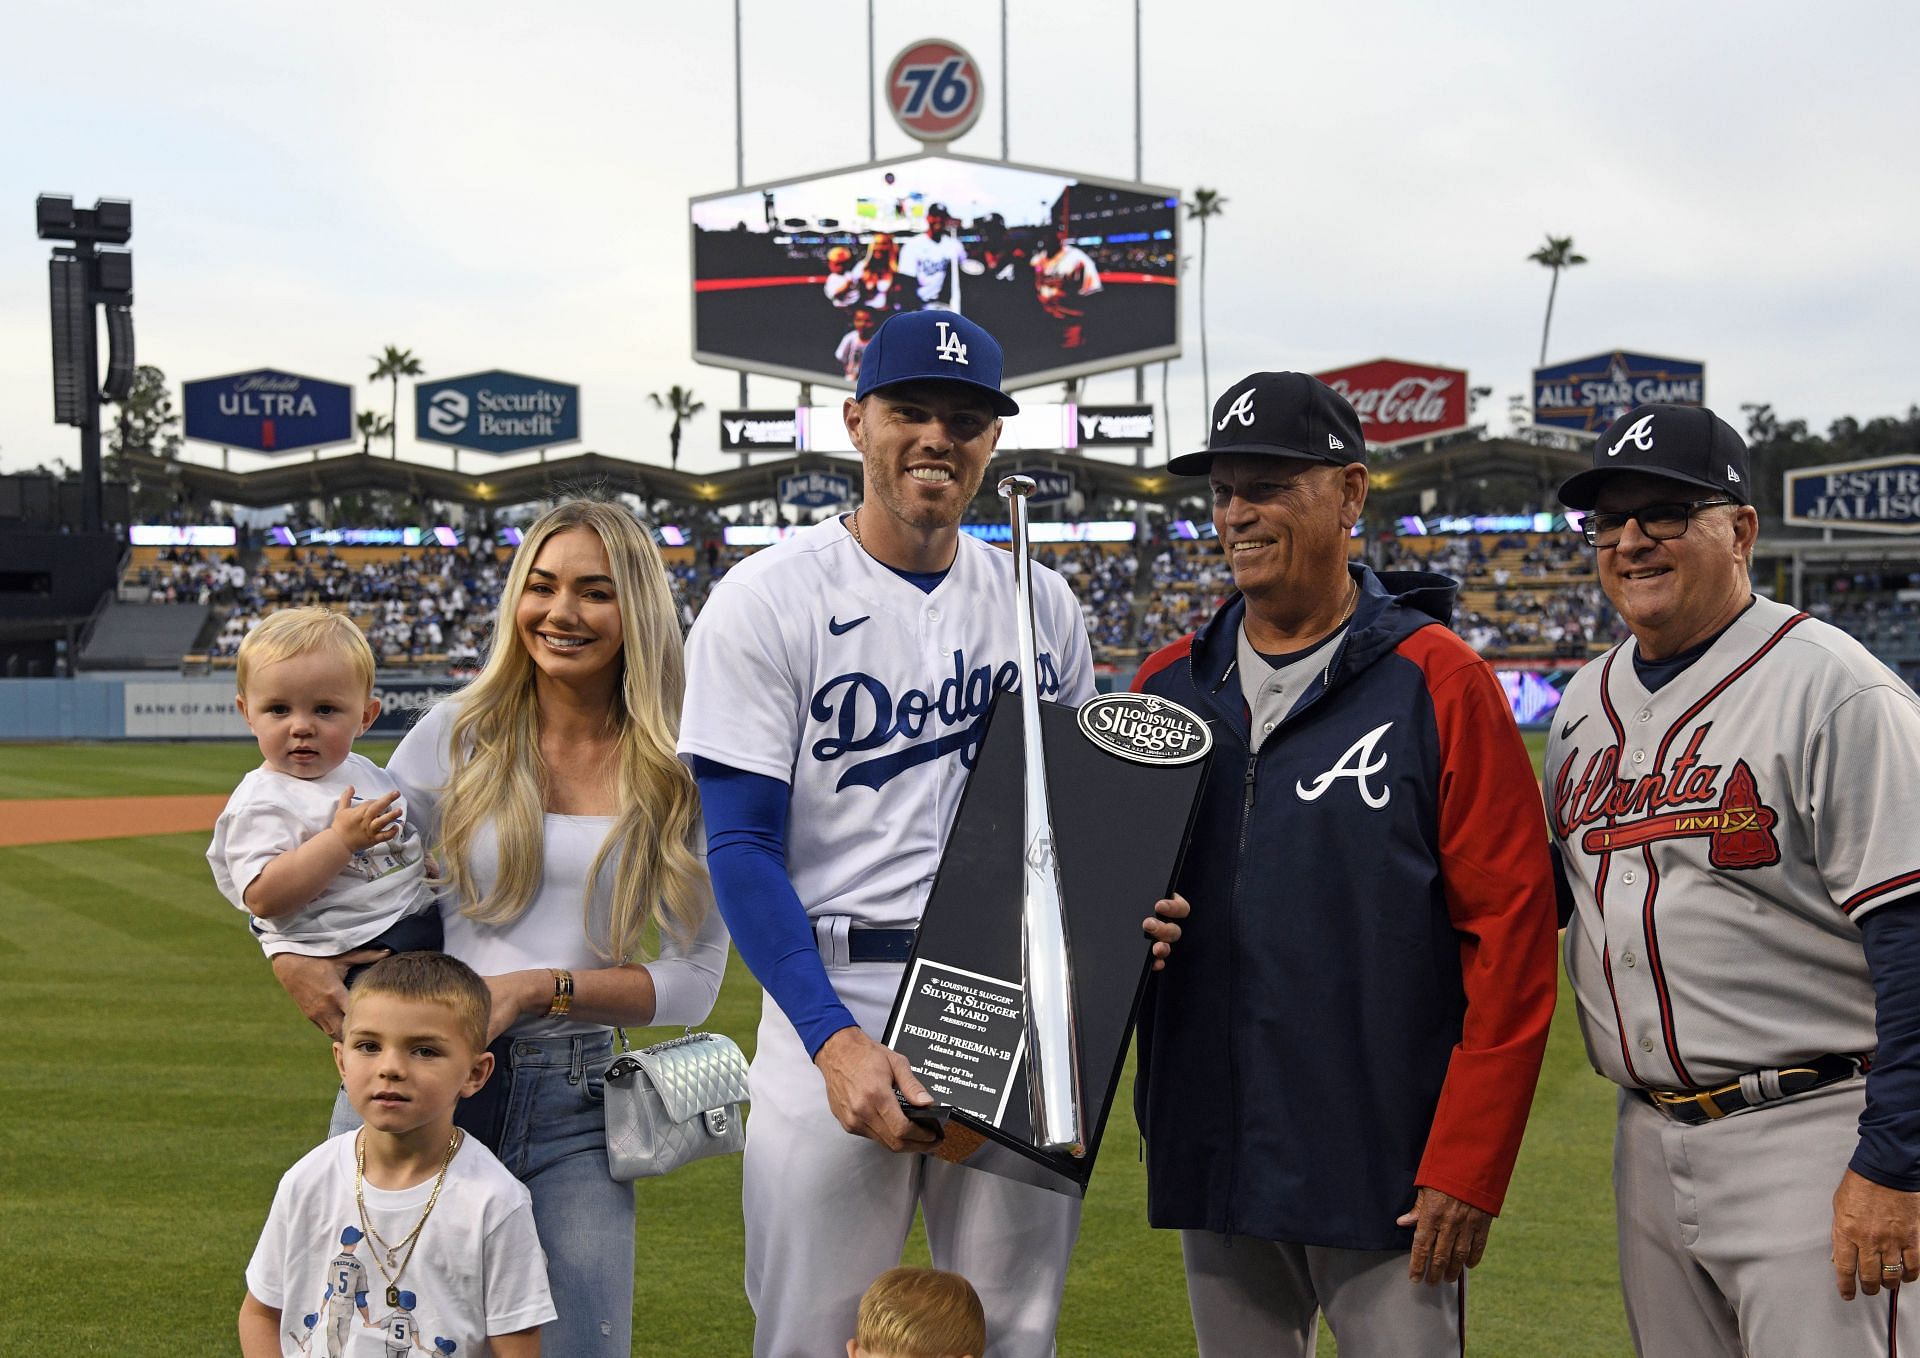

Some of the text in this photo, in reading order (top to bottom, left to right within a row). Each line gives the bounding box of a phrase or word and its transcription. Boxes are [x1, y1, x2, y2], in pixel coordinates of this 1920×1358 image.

[897, 56, 973, 118] 76
[936, 322, 968, 365] LA
[219, 393, 317, 416] ULTRA
[476, 389, 566, 416] Security
[1580, 382, 1633, 406] STAR
[1634, 379, 1699, 403] GAME
[1217, 388, 1256, 431] A
[479, 413, 555, 436] Benefit
[1608, 414, 1654, 456] A
[809, 472, 847, 501] BEAM
[134, 703, 176, 715] BANK
[181, 703, 199, 715] OF
[811, 649, 1060, 770] Dodges
[1123, 707, 1193, 733] LOUISVILLE
[1095, 706, 1195, 750] Slugger
[1296, 722, 1393, 808] A
[1554, 720, 1722, 841] Atlanta
[940, 979, 978, 995] LOUISVILLE
[920, 983, 1017, 1019] SILVER SLUGGER
[944, 1002, 990, 1023] AWARD
[939, 1015, 987, 1033] PRESENTED TO
[903, 1023, 1011, 1061] FREDDIE FREEMAN-1B
[928, 1043, 980, 1063] Atlanta Braves
[923, 1059, 974, 1079] Member Of The
[923, 1069, 947, 1081] League
[947, 1075, 978, 1089] Offensive
[979, 1083, 997, 1095] Team
[333, 1261, 361, 1270] FREEMAN
[338, 1271, 349, 1294] 5
[394, 1324, 405, 1340] 5
